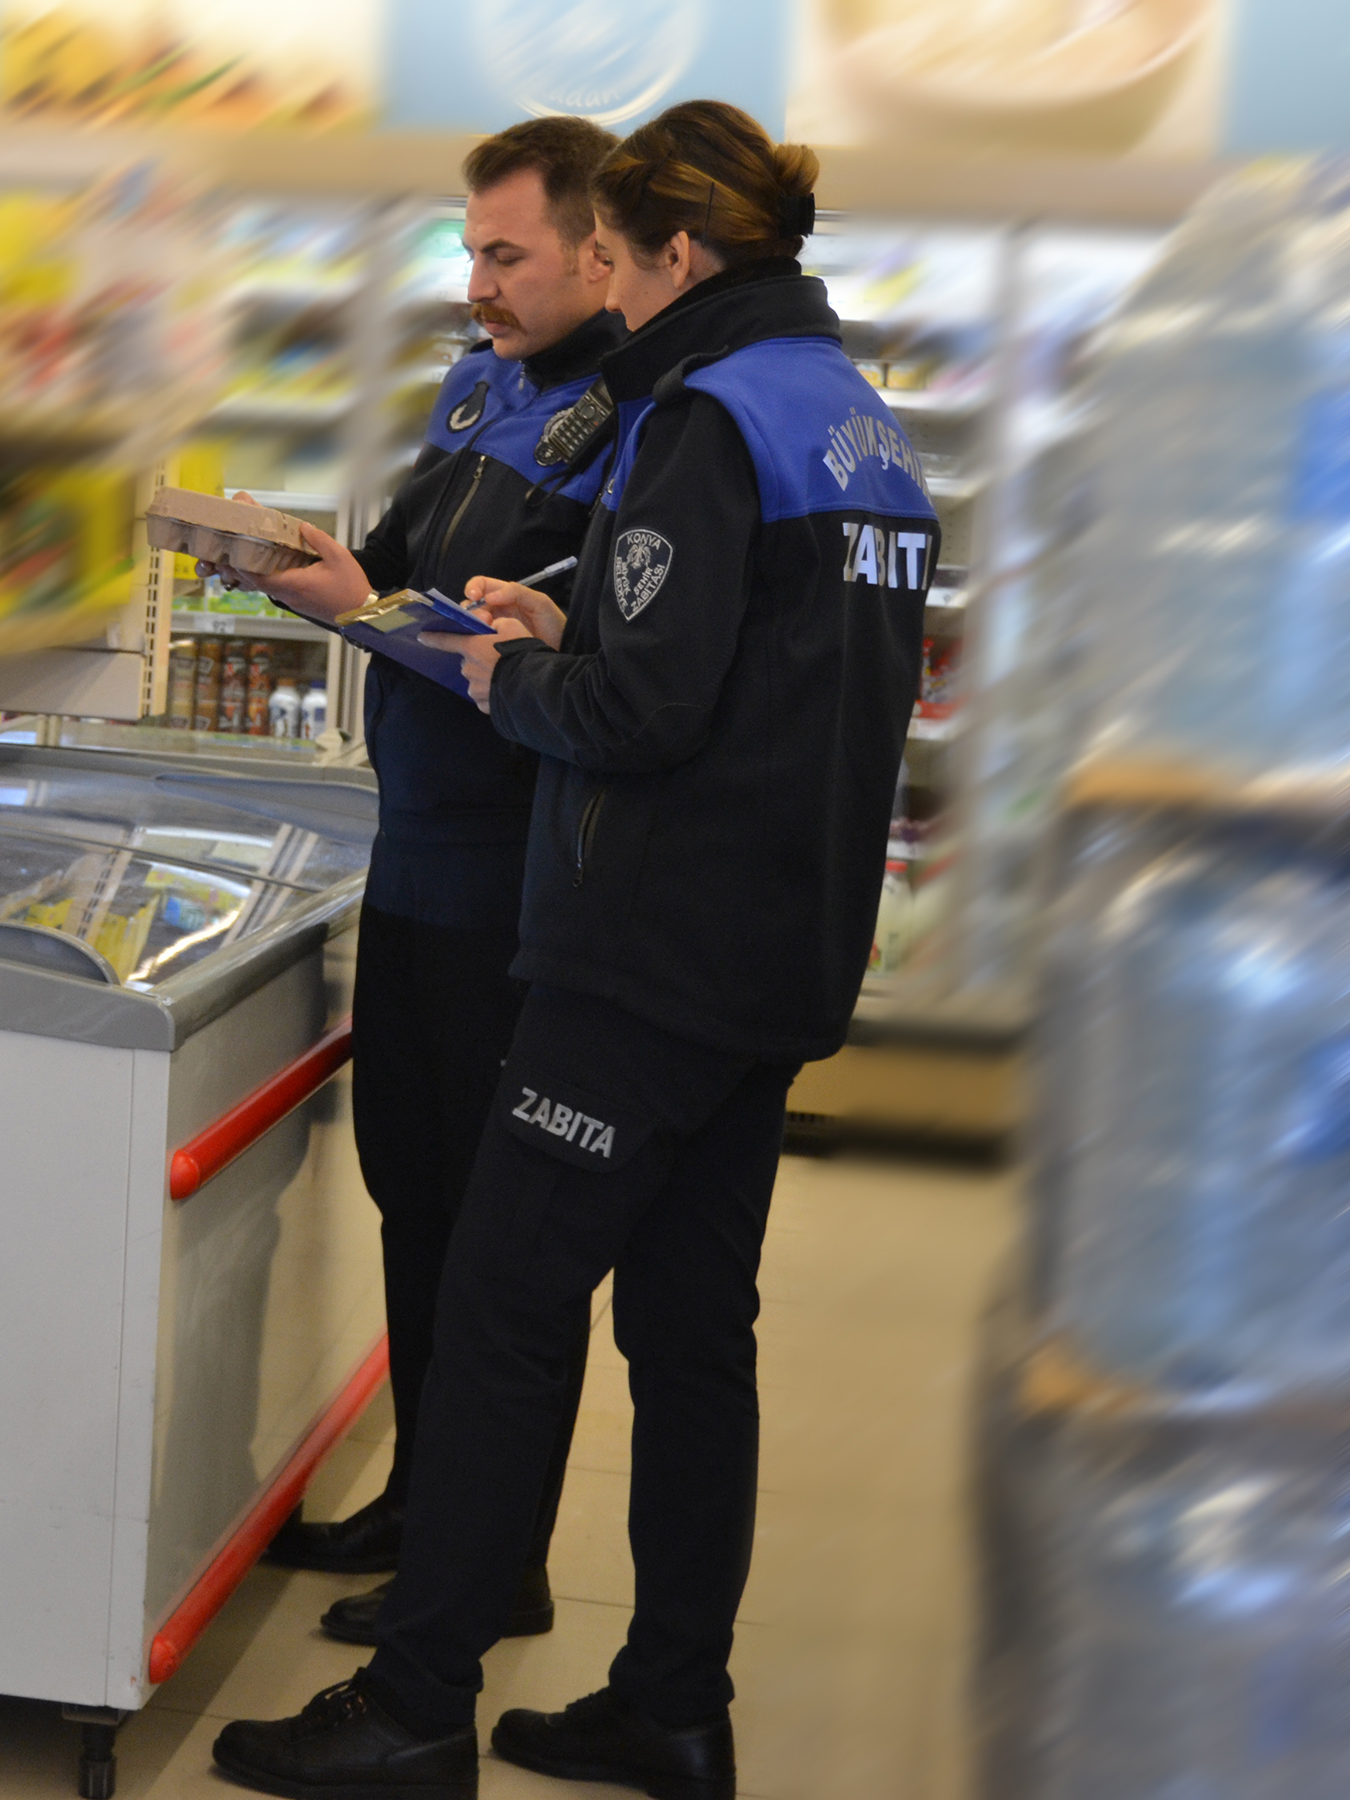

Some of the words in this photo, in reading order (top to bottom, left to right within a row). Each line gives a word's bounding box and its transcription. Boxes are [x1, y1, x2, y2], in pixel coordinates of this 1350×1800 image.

[626, 533, 661, 550] KONYA
[842, 522, 932, 590] ZABIT
[630, 564, 666, 612] ZABITASI
[512, 1086, 616, 1158] ZABITA
